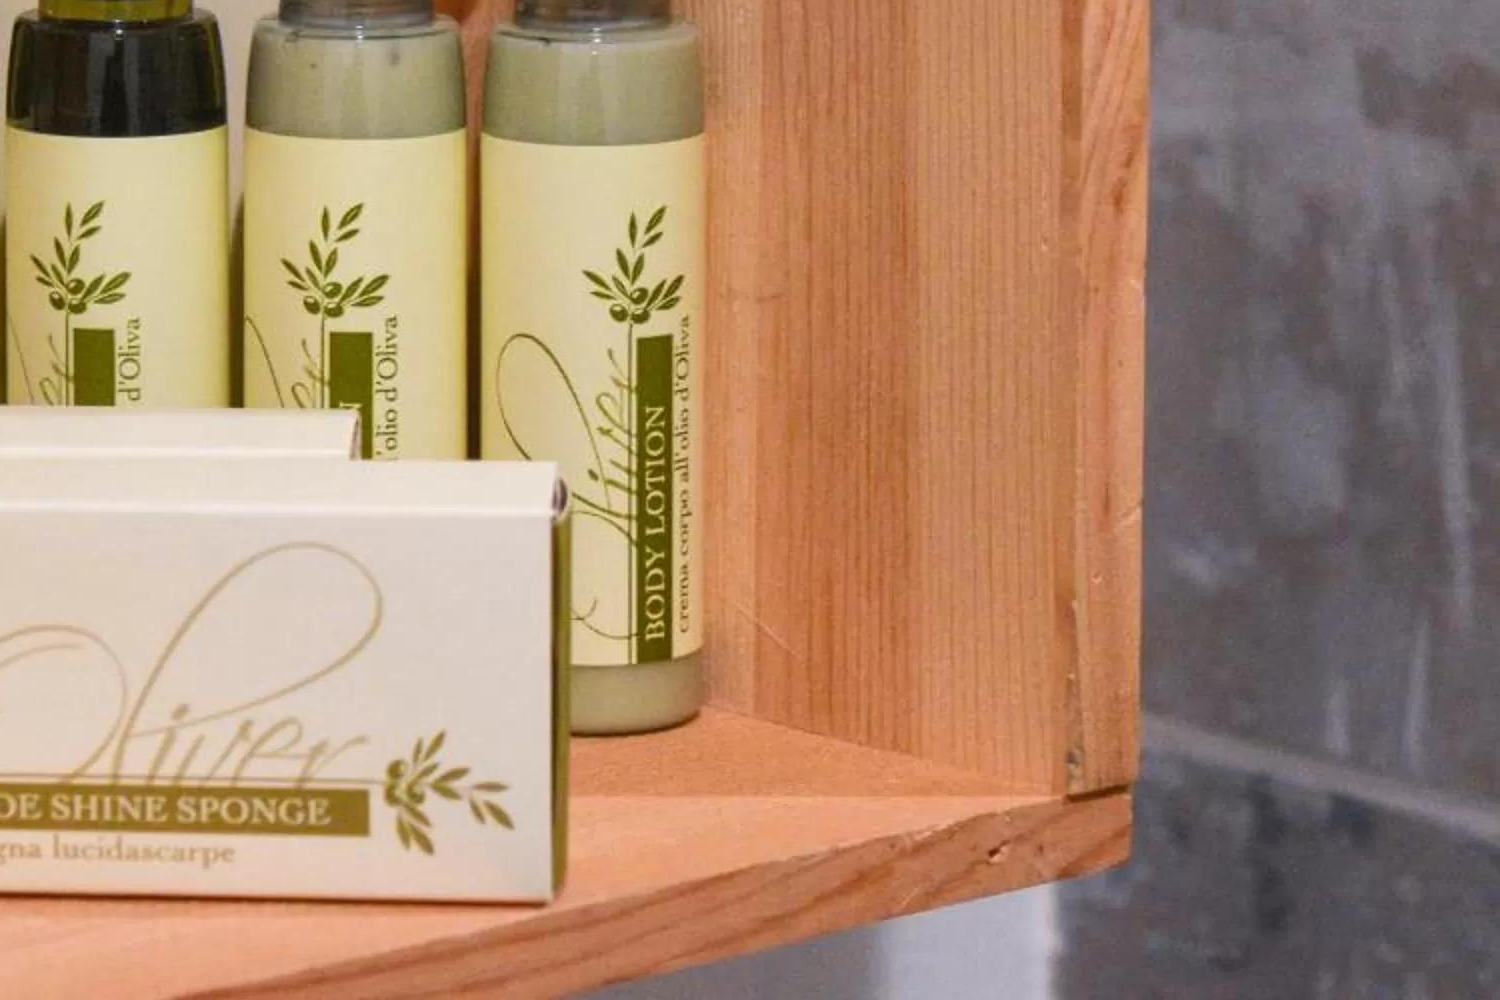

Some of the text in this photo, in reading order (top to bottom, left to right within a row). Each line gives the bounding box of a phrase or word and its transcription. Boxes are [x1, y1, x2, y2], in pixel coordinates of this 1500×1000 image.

[117, 317, 141, 402] d'Oliva
[374, 315, 399, 403] d'Oliva
[674, 315, 690, 401] d'Oliva
[644, 405, 667, 641] BODY LOTION
[678, 490, 693, 557] corpo
[678, 563, 691, 634] crema
[50, 794, 169, 824] SHINE
[176, 797, 333, 827] SPONGE
[51, 834, 237, 870] lucidascarpe
